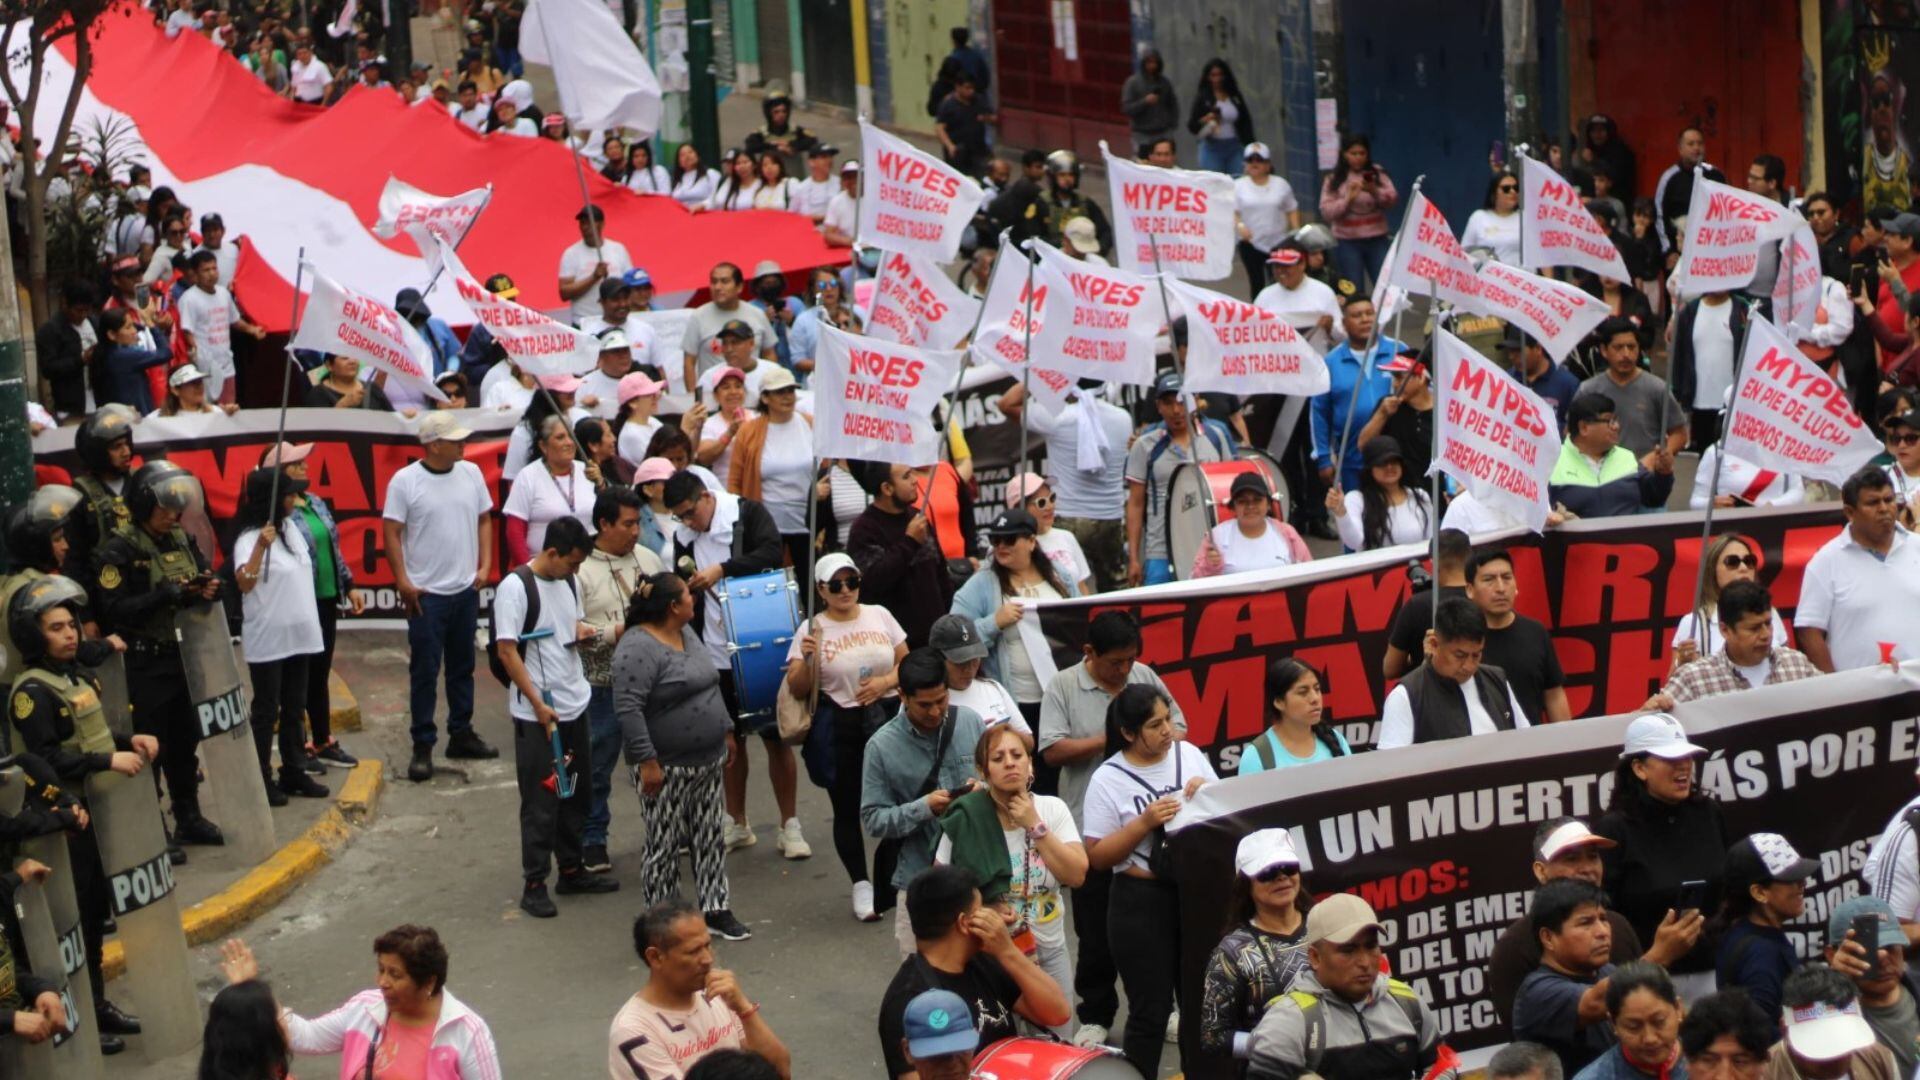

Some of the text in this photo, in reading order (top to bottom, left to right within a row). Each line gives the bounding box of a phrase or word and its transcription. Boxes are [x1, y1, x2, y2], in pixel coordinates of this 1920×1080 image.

[876, 147, 961, 199] MYPES
[1123, 182, 1208, 214] MYPES
[1705, 192, 1778, 222] MYPES
[1168, 218, 1206, 237] LUCHA
[1416, 222, 1431, 243] EN
[343, 300, 360, 321] EN
[481, 308, 502, 327] PIE
[504, 308, 523, 326] DE
[338, 322, 387, 359] QUEREMOS
[524, 333, 576, 357] TRABAJAR
[1233, 326, 1249, 344] DE
[1253, 322, 1296, 343] LUCHA
[1249, 354, 1301, 375] TRABAJAR
[845, 380, 865, 401] EN
[1452, 358, 1546, 437] MYPES
[1755, 347, 1863, 429] MYPES
[843, 412, 895, 442] QUEREMOS
[1448, 399, 1466, 425] EN
[1464, 407, 1490, 438] PIE
[1489, 421, 1512, 448] DE
[1741, 377, 1851, 447] EN PIE DE LUCHA
[823, 630, 889, 655] CHAMPION
[1319, 804, 1394, 863] UN
[1692, 748, 1768, 801] ÁS
[1778, 726, 1876, 790] POR
[1407, 905, 1447, 940] DE
[1400, 938, 1458, 975] DEL
[1439, 965, 1490, 1000] TO
